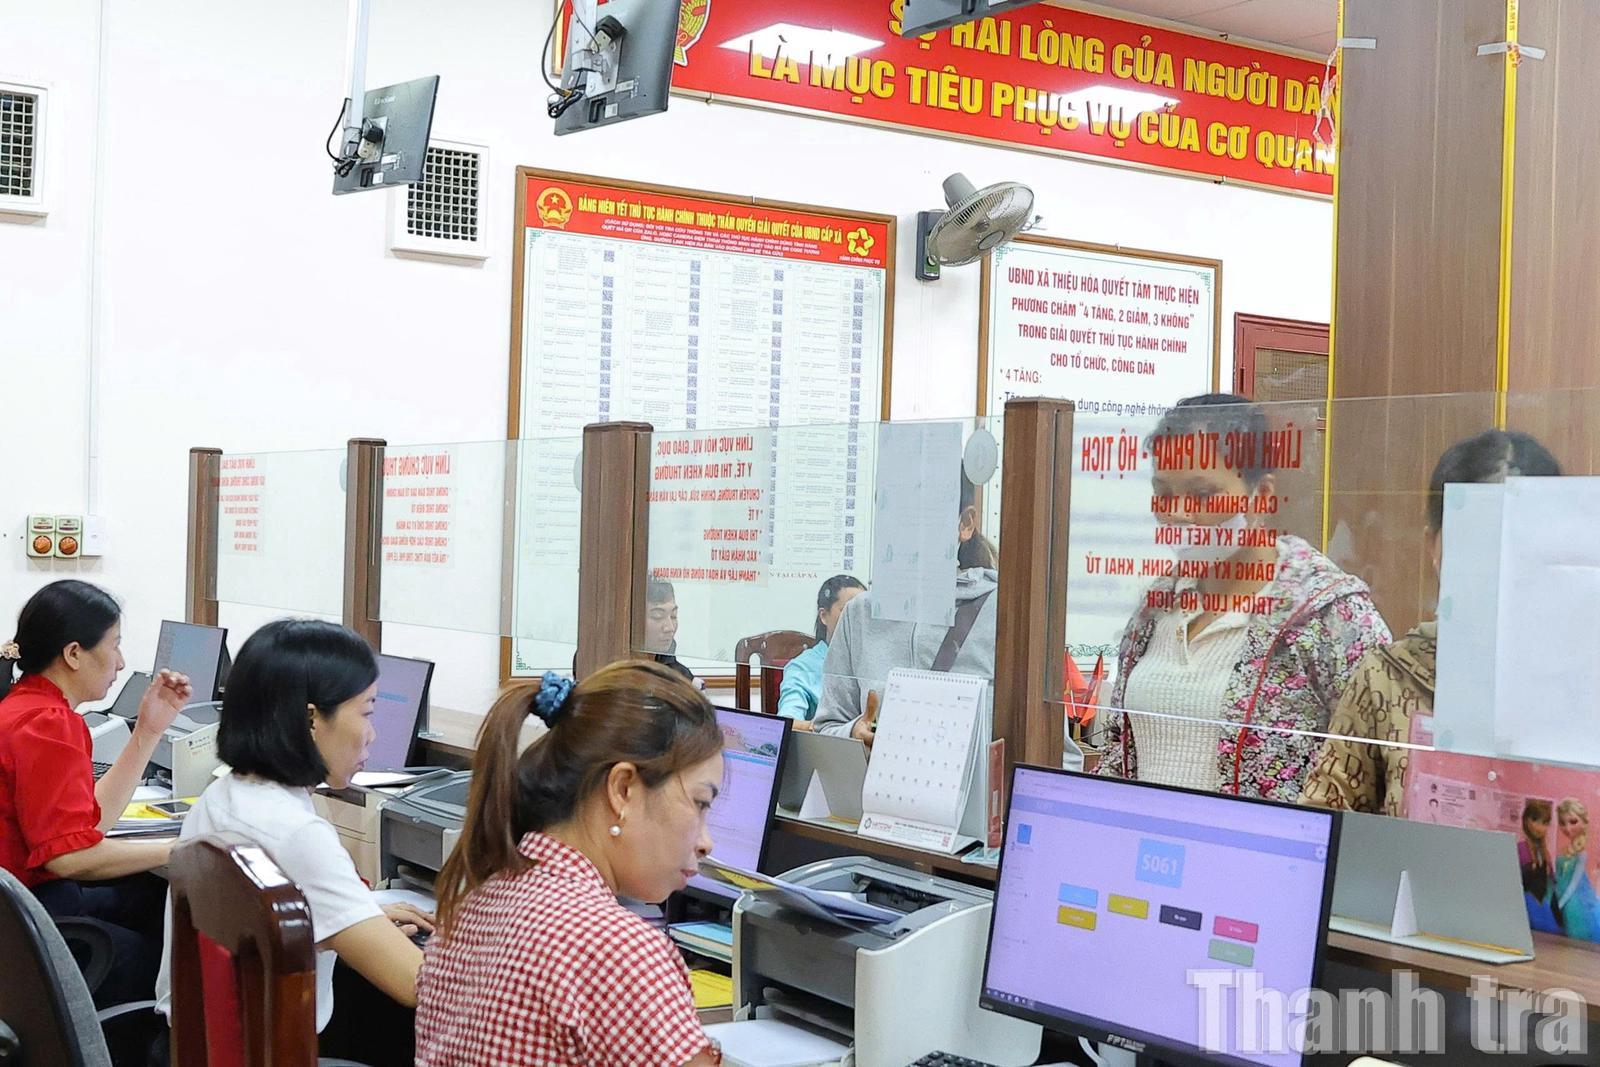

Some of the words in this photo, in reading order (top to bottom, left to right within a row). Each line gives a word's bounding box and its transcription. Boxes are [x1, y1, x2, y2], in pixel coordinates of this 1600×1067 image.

[1020, 19, 1104, 74] LÒNG
[1112, 34, 1175, 88] CỦA
[1184, 58, 1278, 108] NGƯỜI
[749, 35, 800, 84] LÀ
[808, 45, 895, 104] MỤC
[905, 64, 983, 114] TIÊU
[992, 82, 1080, 134] PHỤC
[1085, 100, 1135, 147] VỤ
[1137, 100, 1200, 153] CỦA
[1207, 121, 1250, 159] CƠ
[1008, 267, 1034, 285] UBND
[1037, 268, 1049, 287] XÃ
[1053, 270, 1078, 293] THIỆU
[1102, 274, 1129, 297] QUYẾT
[1132, 280, 1150, 299] TÂM
[1155, 284, 1176, 305] THỰC
[1179, 284, 1199, 308] HIỆN
[1012, 297, 1048, 314] PHƯƠNG
[1051, 300, 1076, 316] CHÂM
[1092, 303, 1116, 322] TĂNG,
[1119, 312, 1125, 322] 2
[1127, 308, 1151, 325] GIẢM,
[1153, 314, 1158, 326] 3
[1019, 324, 1047, 339] TRONG
[1050, 324, 1067, 341] GIẢI
[1070, 327, 1096, 344] QUYẾT
[1099, 329, 1115, 346] THỦ
[1118, 334, 1133, 351] TỤC
[1136, 334, 1158, 350] HÀNH
[1161, 337, 1187, 353] CHÍNH
[1051, 353, 1067, 367] CHO
[1071, 351, 1081, 368] TỔ
[1112, 359, 1135, 373] CÔNG
[1137, 359, 1155, 375] DÂN
